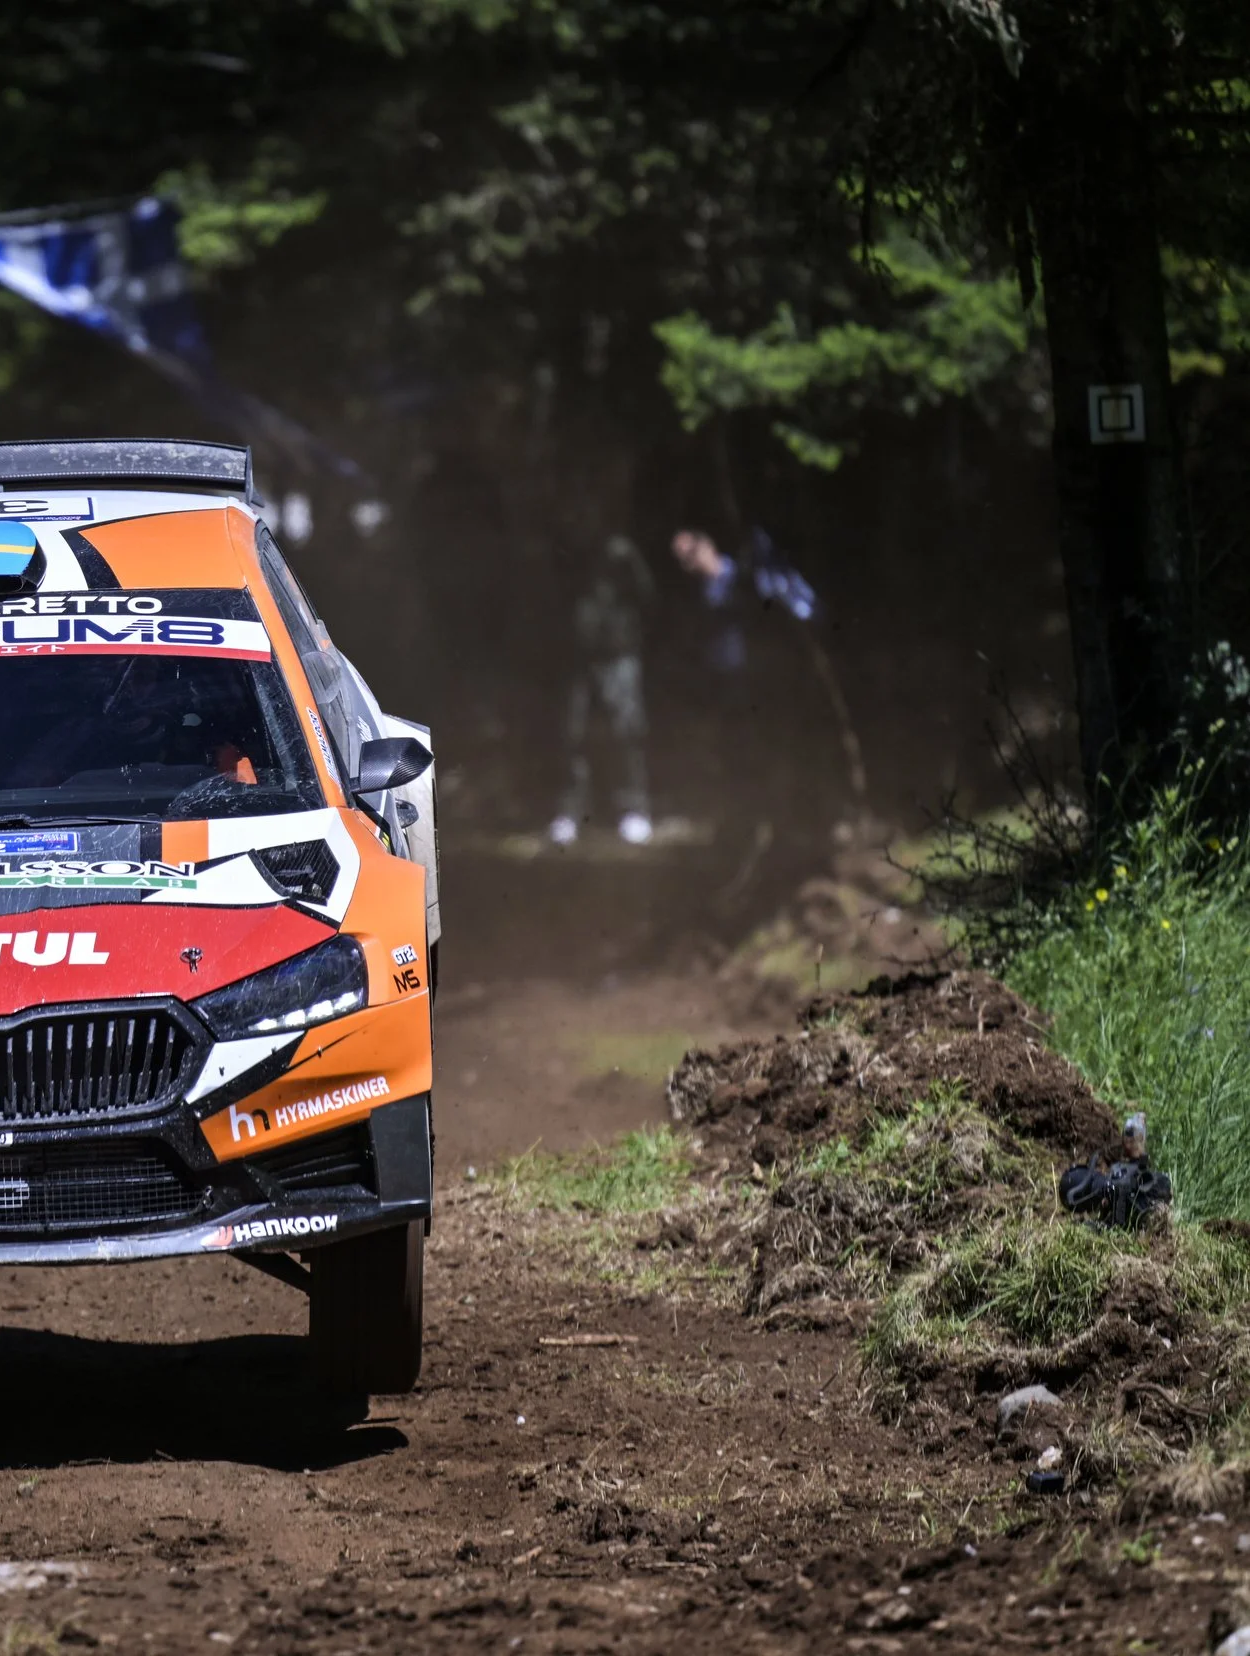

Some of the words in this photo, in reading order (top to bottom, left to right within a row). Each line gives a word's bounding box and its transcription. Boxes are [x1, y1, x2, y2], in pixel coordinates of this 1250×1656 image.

[132, 878, 183, 888] AB
[393, 969, 421, 994] MS
[275, 1076, 390, 1128] HYRMASKINER
